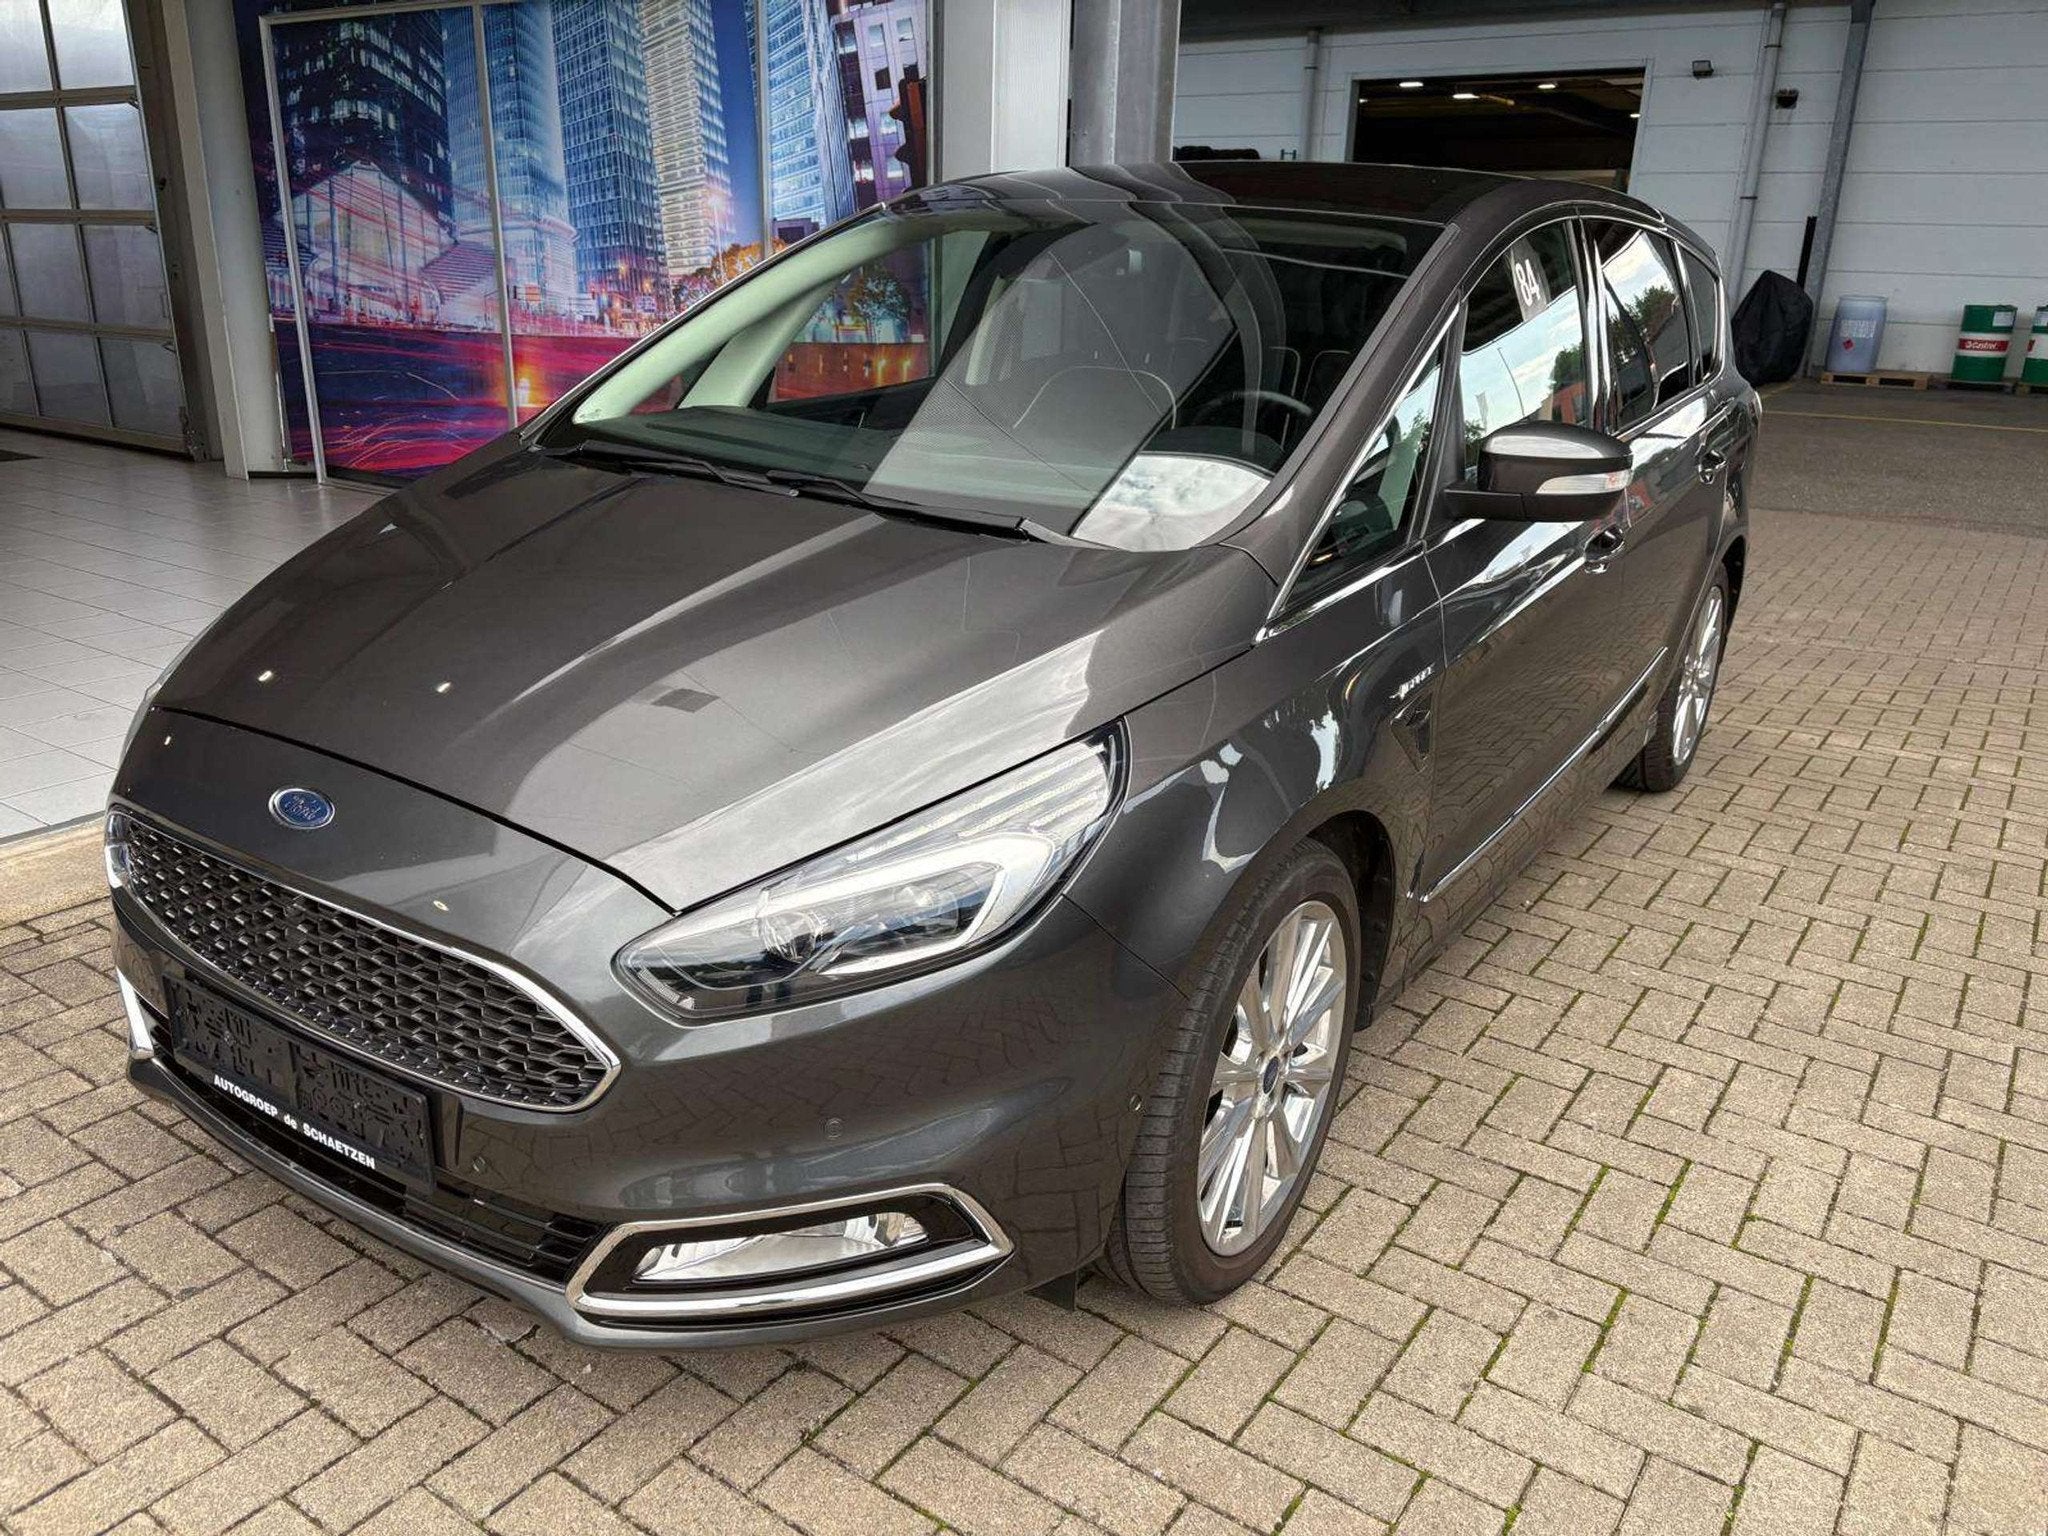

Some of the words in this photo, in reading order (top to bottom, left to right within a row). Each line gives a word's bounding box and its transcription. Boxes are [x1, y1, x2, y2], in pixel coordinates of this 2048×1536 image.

[1515, 258, 1541, 307] 84
[213, 1073, 278, 1118] AUTOGROEP
[283, 1113, 298, 1130] de
[303, 1122, 376, 1170] SCHAETZEN
